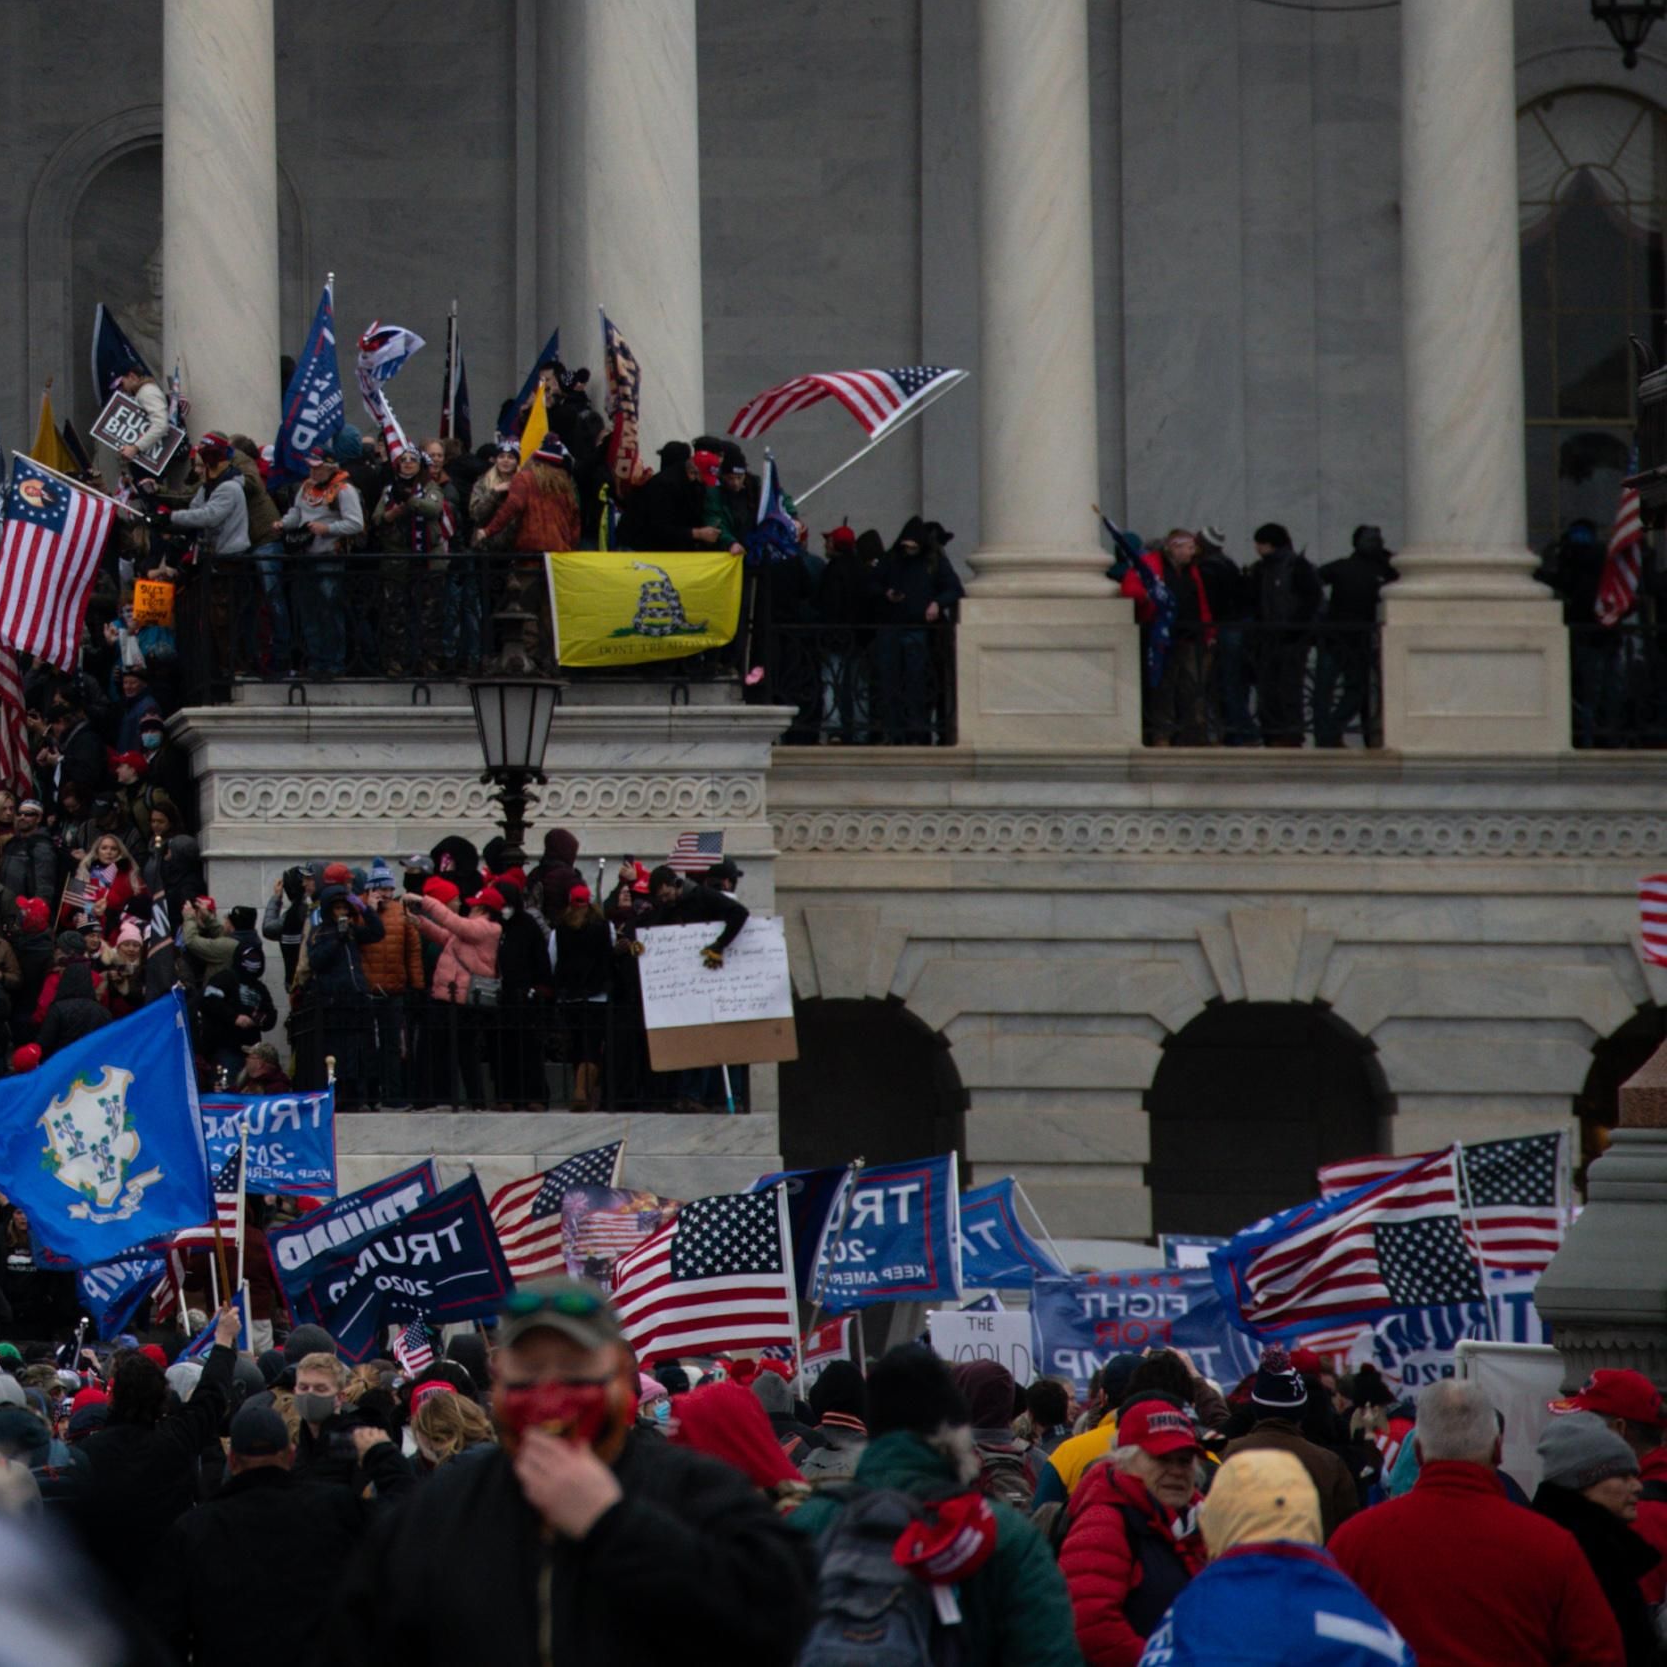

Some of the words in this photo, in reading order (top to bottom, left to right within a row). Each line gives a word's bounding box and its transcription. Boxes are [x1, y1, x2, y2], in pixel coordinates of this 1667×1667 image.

[103, 415, 164, 461] BIDN
[116, 405, 154, 439] FUC
[965, 1316, 995, 1332] THE
